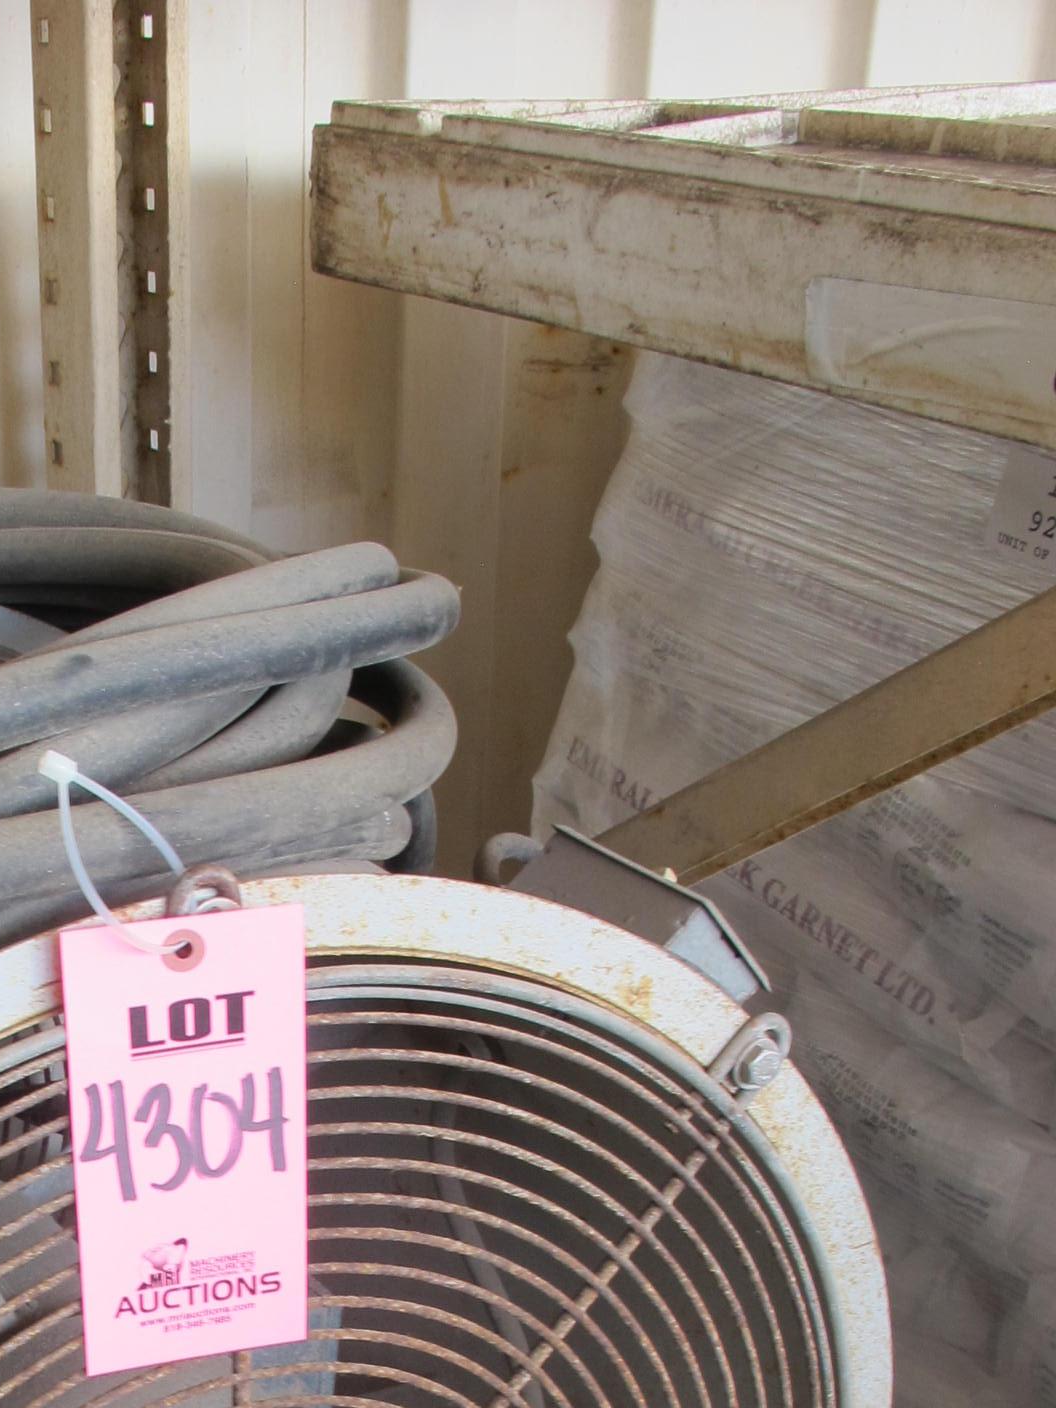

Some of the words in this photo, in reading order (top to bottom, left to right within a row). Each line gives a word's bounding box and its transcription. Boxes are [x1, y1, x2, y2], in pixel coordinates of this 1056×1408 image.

[997, 531, 1028, 553] UNIT
[761, 878, 880, 975] GARNET
[128, 990, 255, 1050] LOT
[80, 1066, 289, 1201] 4304
[115, 1271, 282, 1319] AUCTIONS
